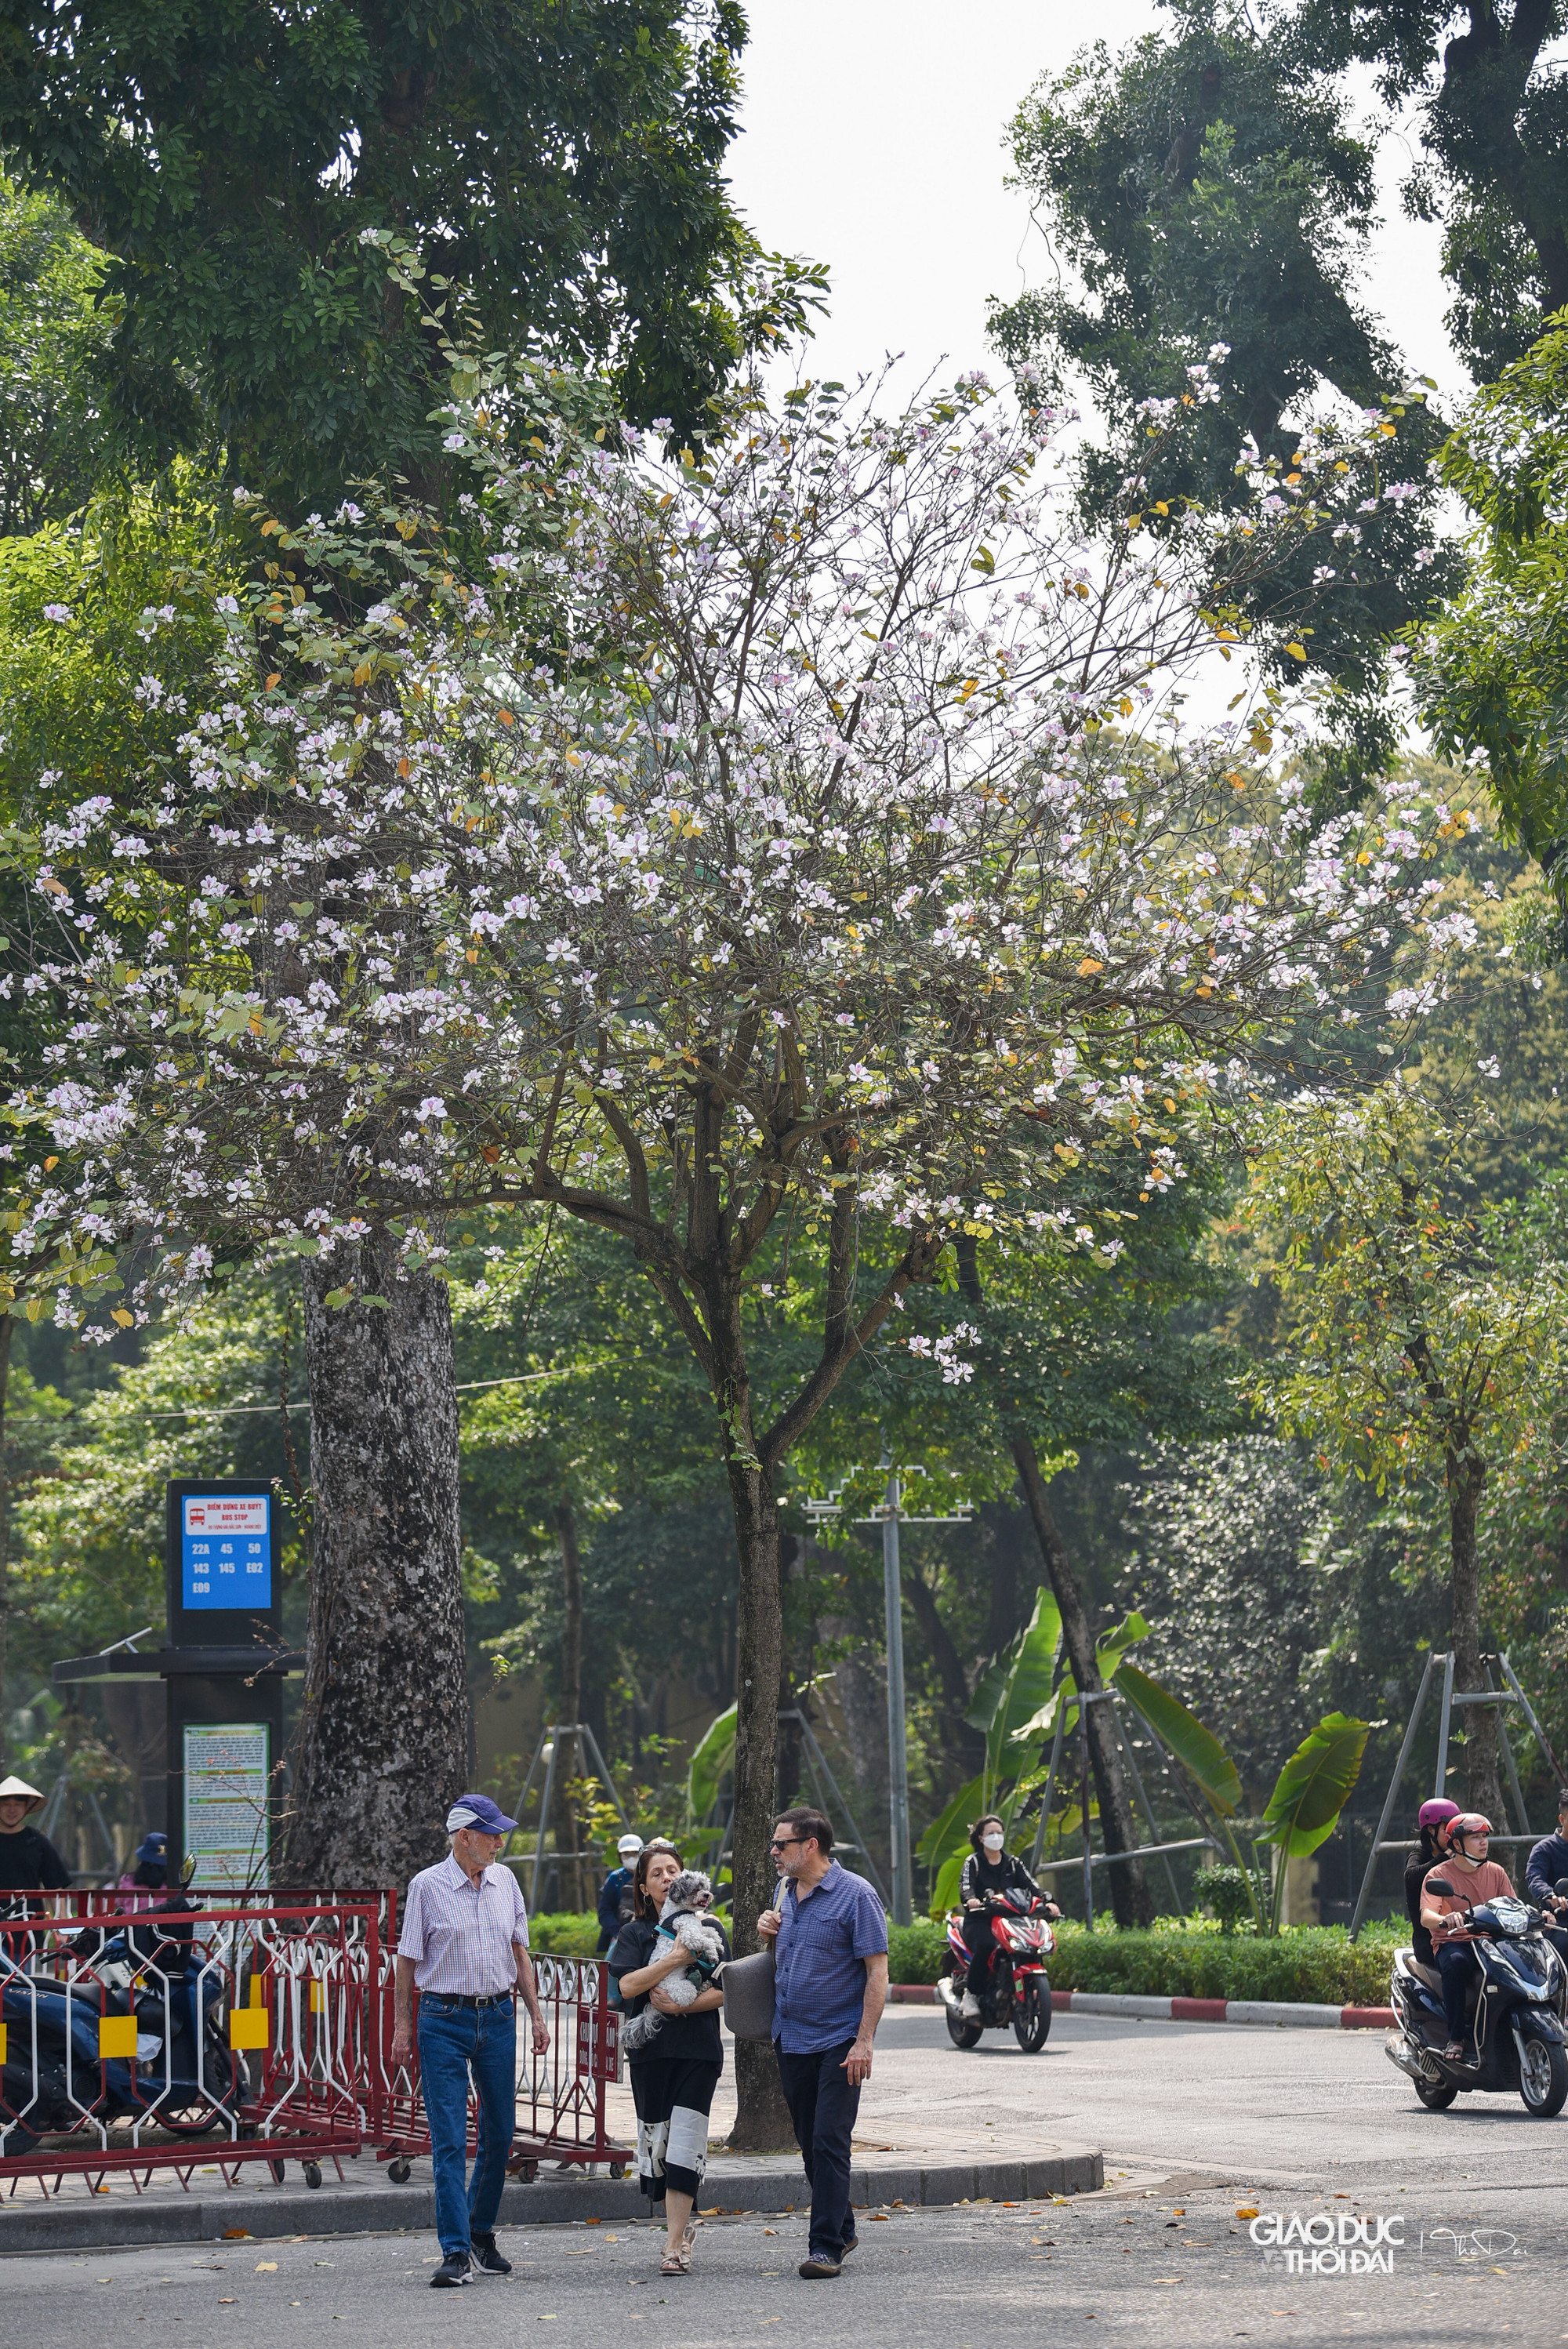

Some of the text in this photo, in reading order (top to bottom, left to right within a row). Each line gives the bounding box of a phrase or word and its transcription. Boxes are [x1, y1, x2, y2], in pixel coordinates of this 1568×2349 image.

[192, 1542, 261, 1555] 22A 45 50
[193, 1562, 263, 1574] 143 145 E02
[192, 1582, 210, 1593] E09
